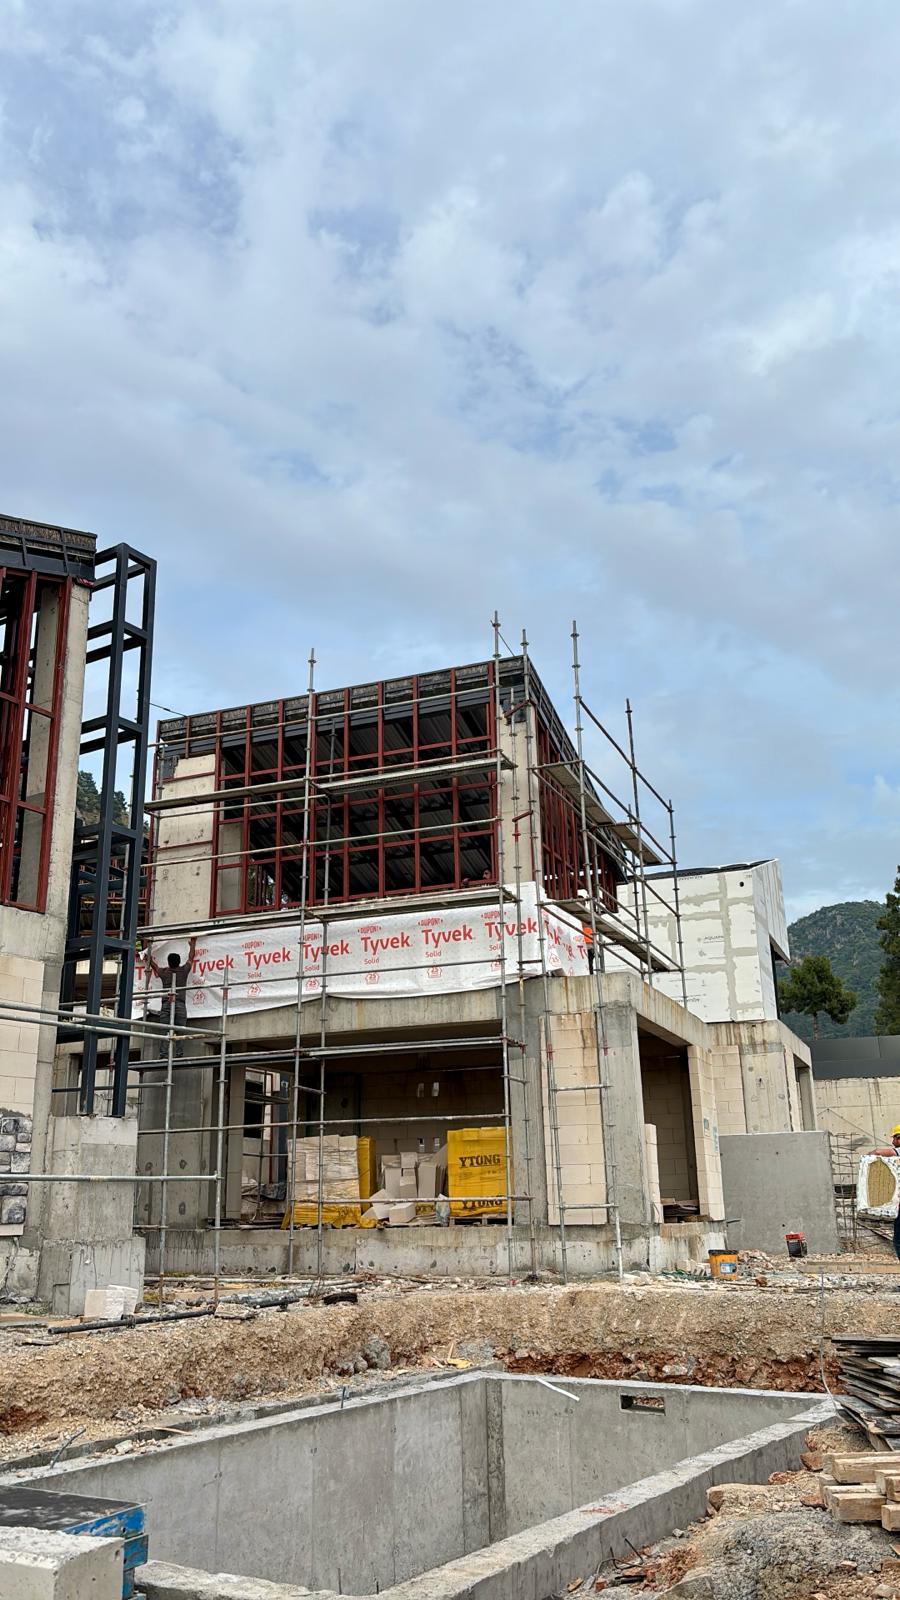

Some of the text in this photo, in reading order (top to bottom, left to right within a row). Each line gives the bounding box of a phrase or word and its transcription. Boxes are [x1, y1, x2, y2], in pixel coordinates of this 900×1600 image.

[484, 910, 502, 919] DUPON
[421, 925, 473, 948] Tyvek
[485, 918, 537, 941] Tyvek
[361, 932, 410, 955] Tyvek
[489, 943, 502, 951] Soli
[192, 954, 234, 977] Tyvek
[244, 947, 291, 970] Tyvek
[305, 964, 320, 972] Solid
[364, 957, 380, 965] Solid
[458, 1153, 501, 1168] YTONG
